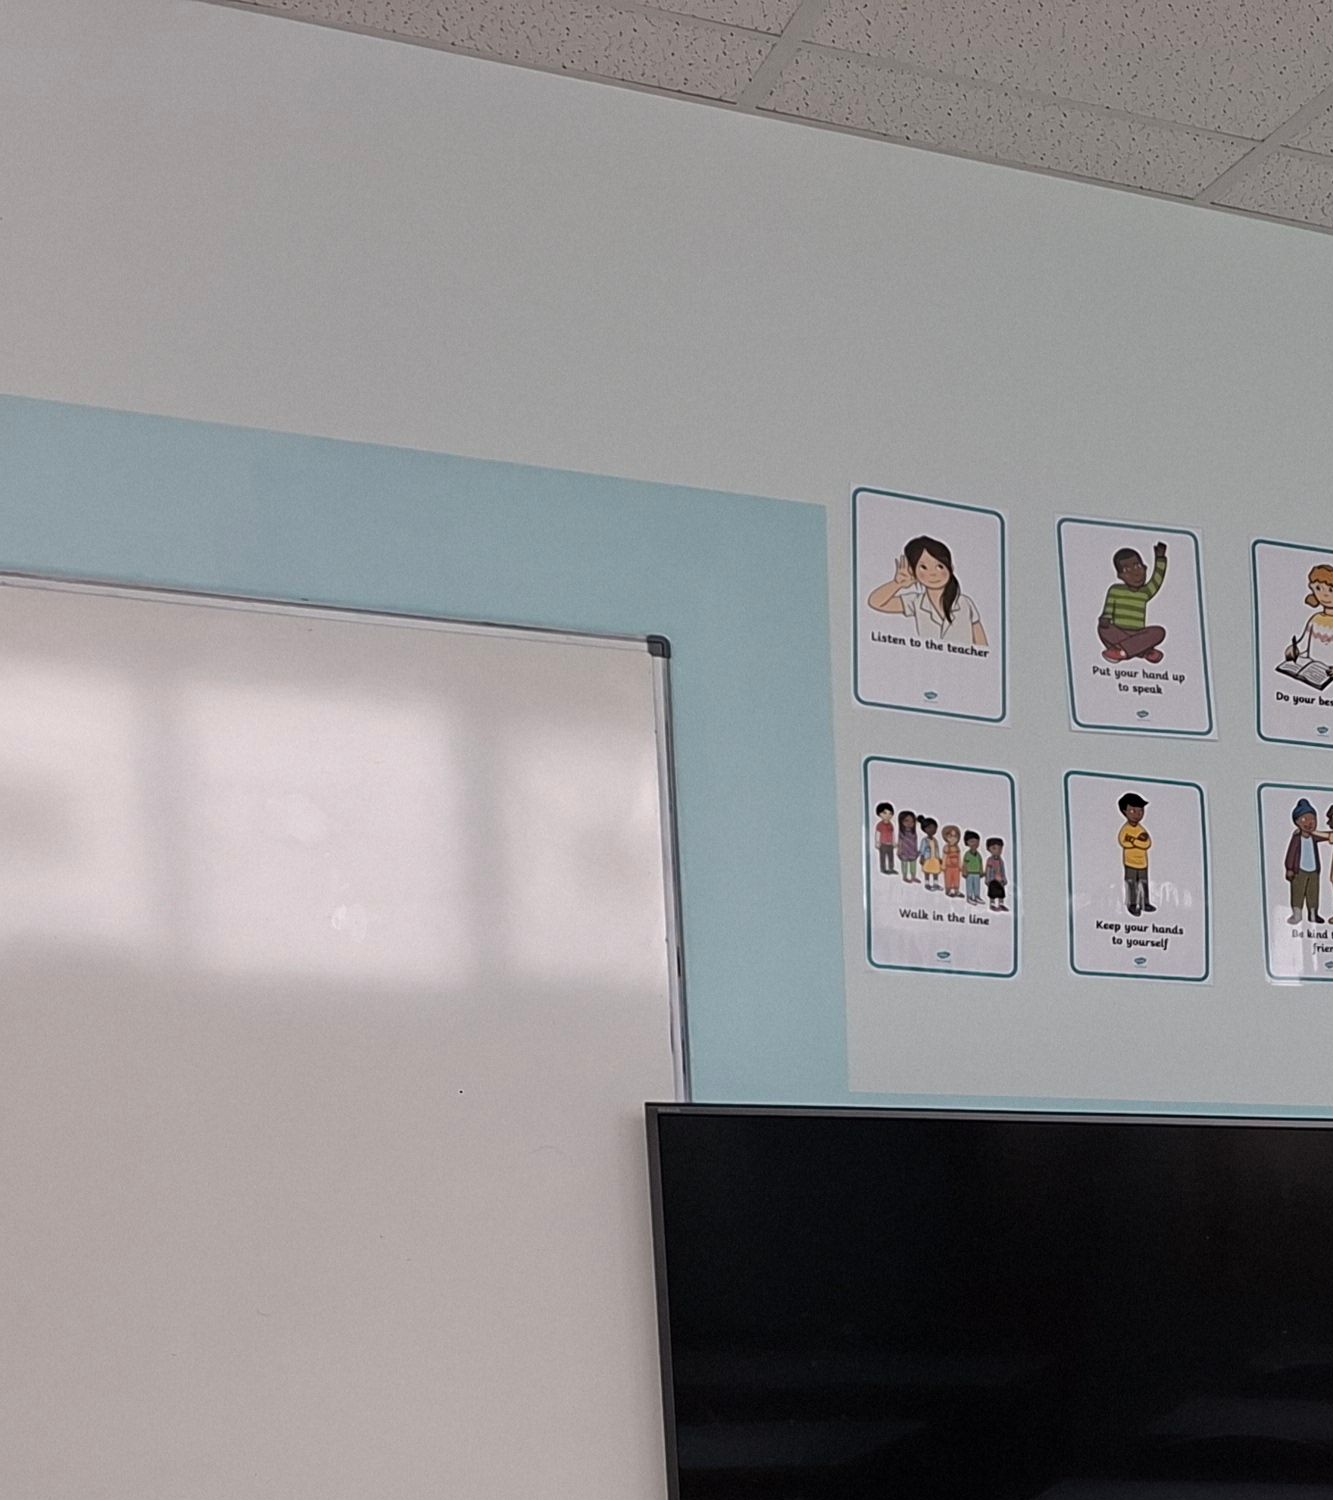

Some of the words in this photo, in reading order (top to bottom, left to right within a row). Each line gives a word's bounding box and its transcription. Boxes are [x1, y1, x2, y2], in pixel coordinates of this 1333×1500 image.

[871, 631, 906, 645] Listen
[910, 638, 921, 648] to
[925, 639, 943, 651] the
[947, 643, 989, 658] teacher
[1092, 665, 1111, 676] Put
[1114, 669, 1139, 679] your
[1142, 669, 1169, 680] hand
[1172, 674, 1185, 684] up
[1118, 683, 1129, 692] to
[1132, 684, 1163, 695] speak
[1276, 691, 1289, 701] Do
[1293, 696, 1315, 705] your
[899, 908, 929, 920] Walk
[932, 911, 943, 921] in
[947, 912, 965, 923] the
[969, 914, 990, 925] line
[1096, 920, 1121, 933] Keep
[1124, 924, 1149, 934] your
[1152, 923, 1184, 935] hands
[1307, 929, 1328, 939] kind
[1112, 936, 1123, 945] to
[1126, 938, 1169, 951] yourself
